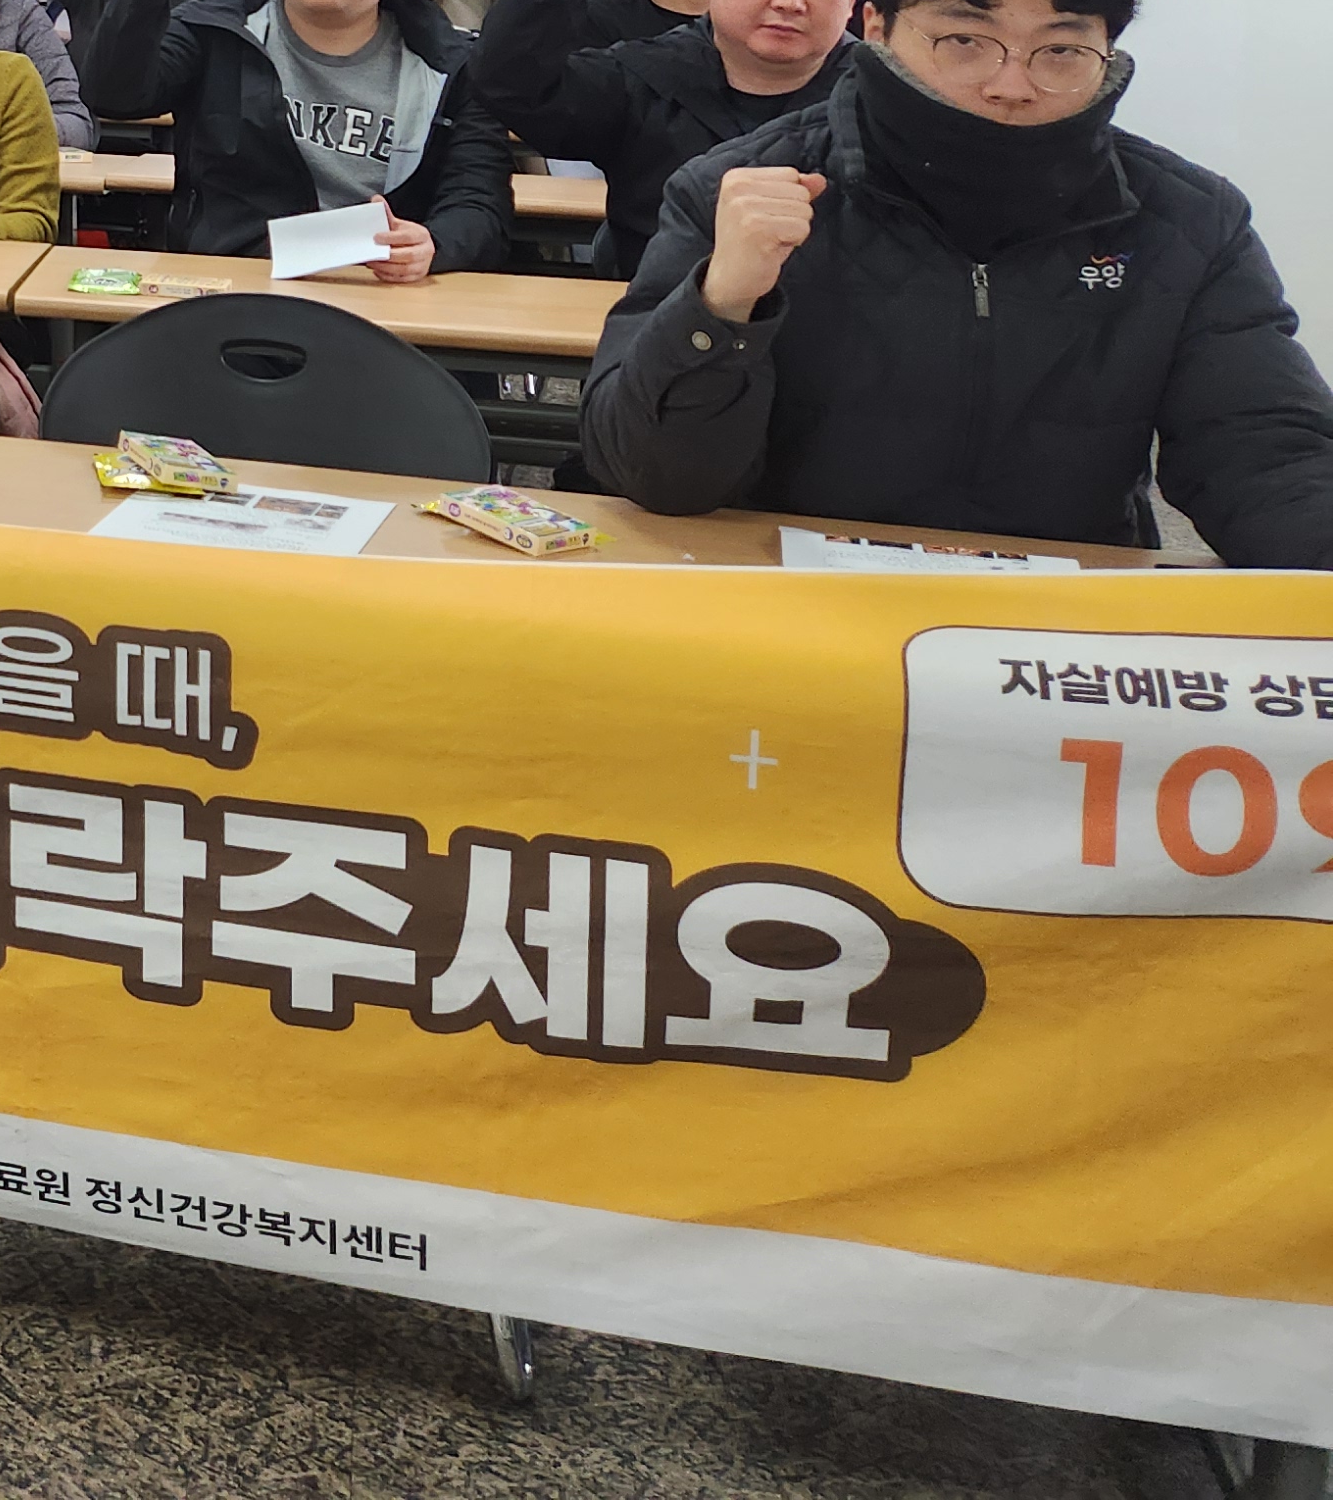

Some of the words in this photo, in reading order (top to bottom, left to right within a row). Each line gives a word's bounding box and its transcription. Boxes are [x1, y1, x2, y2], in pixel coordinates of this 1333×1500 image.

[1078, 262, 1126, 290] 우양
[115, 642, 238, 752] 때,
[998, 658, 1230, 713] 자살예방
[1059, 737, 1333, 878] 10
[84, 1176, 428, 1272] 정신건강복지센터
